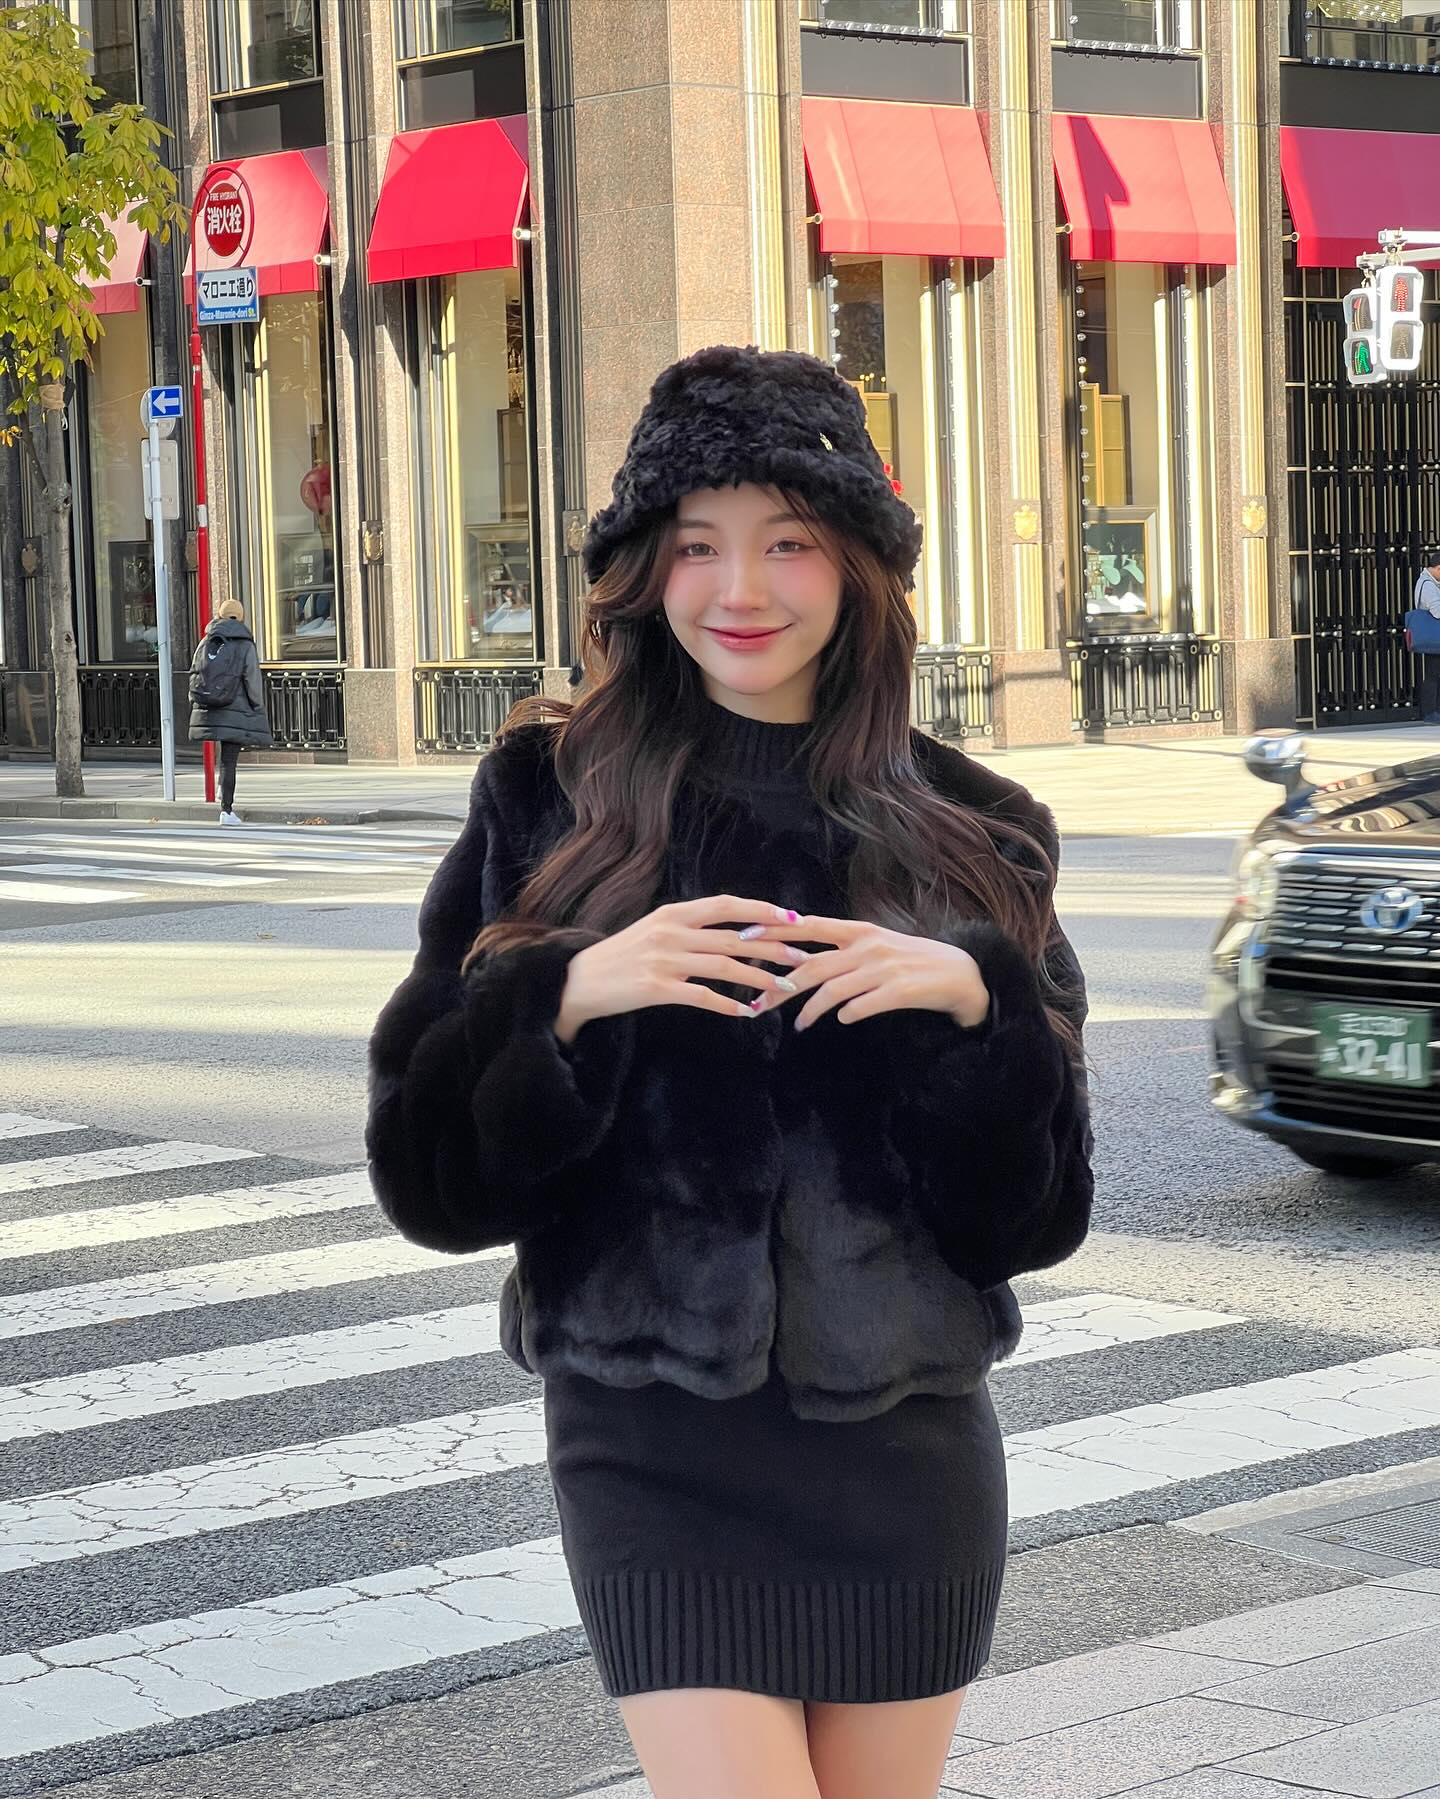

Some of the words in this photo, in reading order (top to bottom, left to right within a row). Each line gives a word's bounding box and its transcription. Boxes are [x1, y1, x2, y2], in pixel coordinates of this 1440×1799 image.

[210, 192, 219, 201] FIRE
[220, 191, 237, 200] HYDRANT
[207, 203, 242, 235] 消火栓
[202, 277, 254, 299] マロニエ通り
[1337, 1036, 1422, 1080] 32-41
